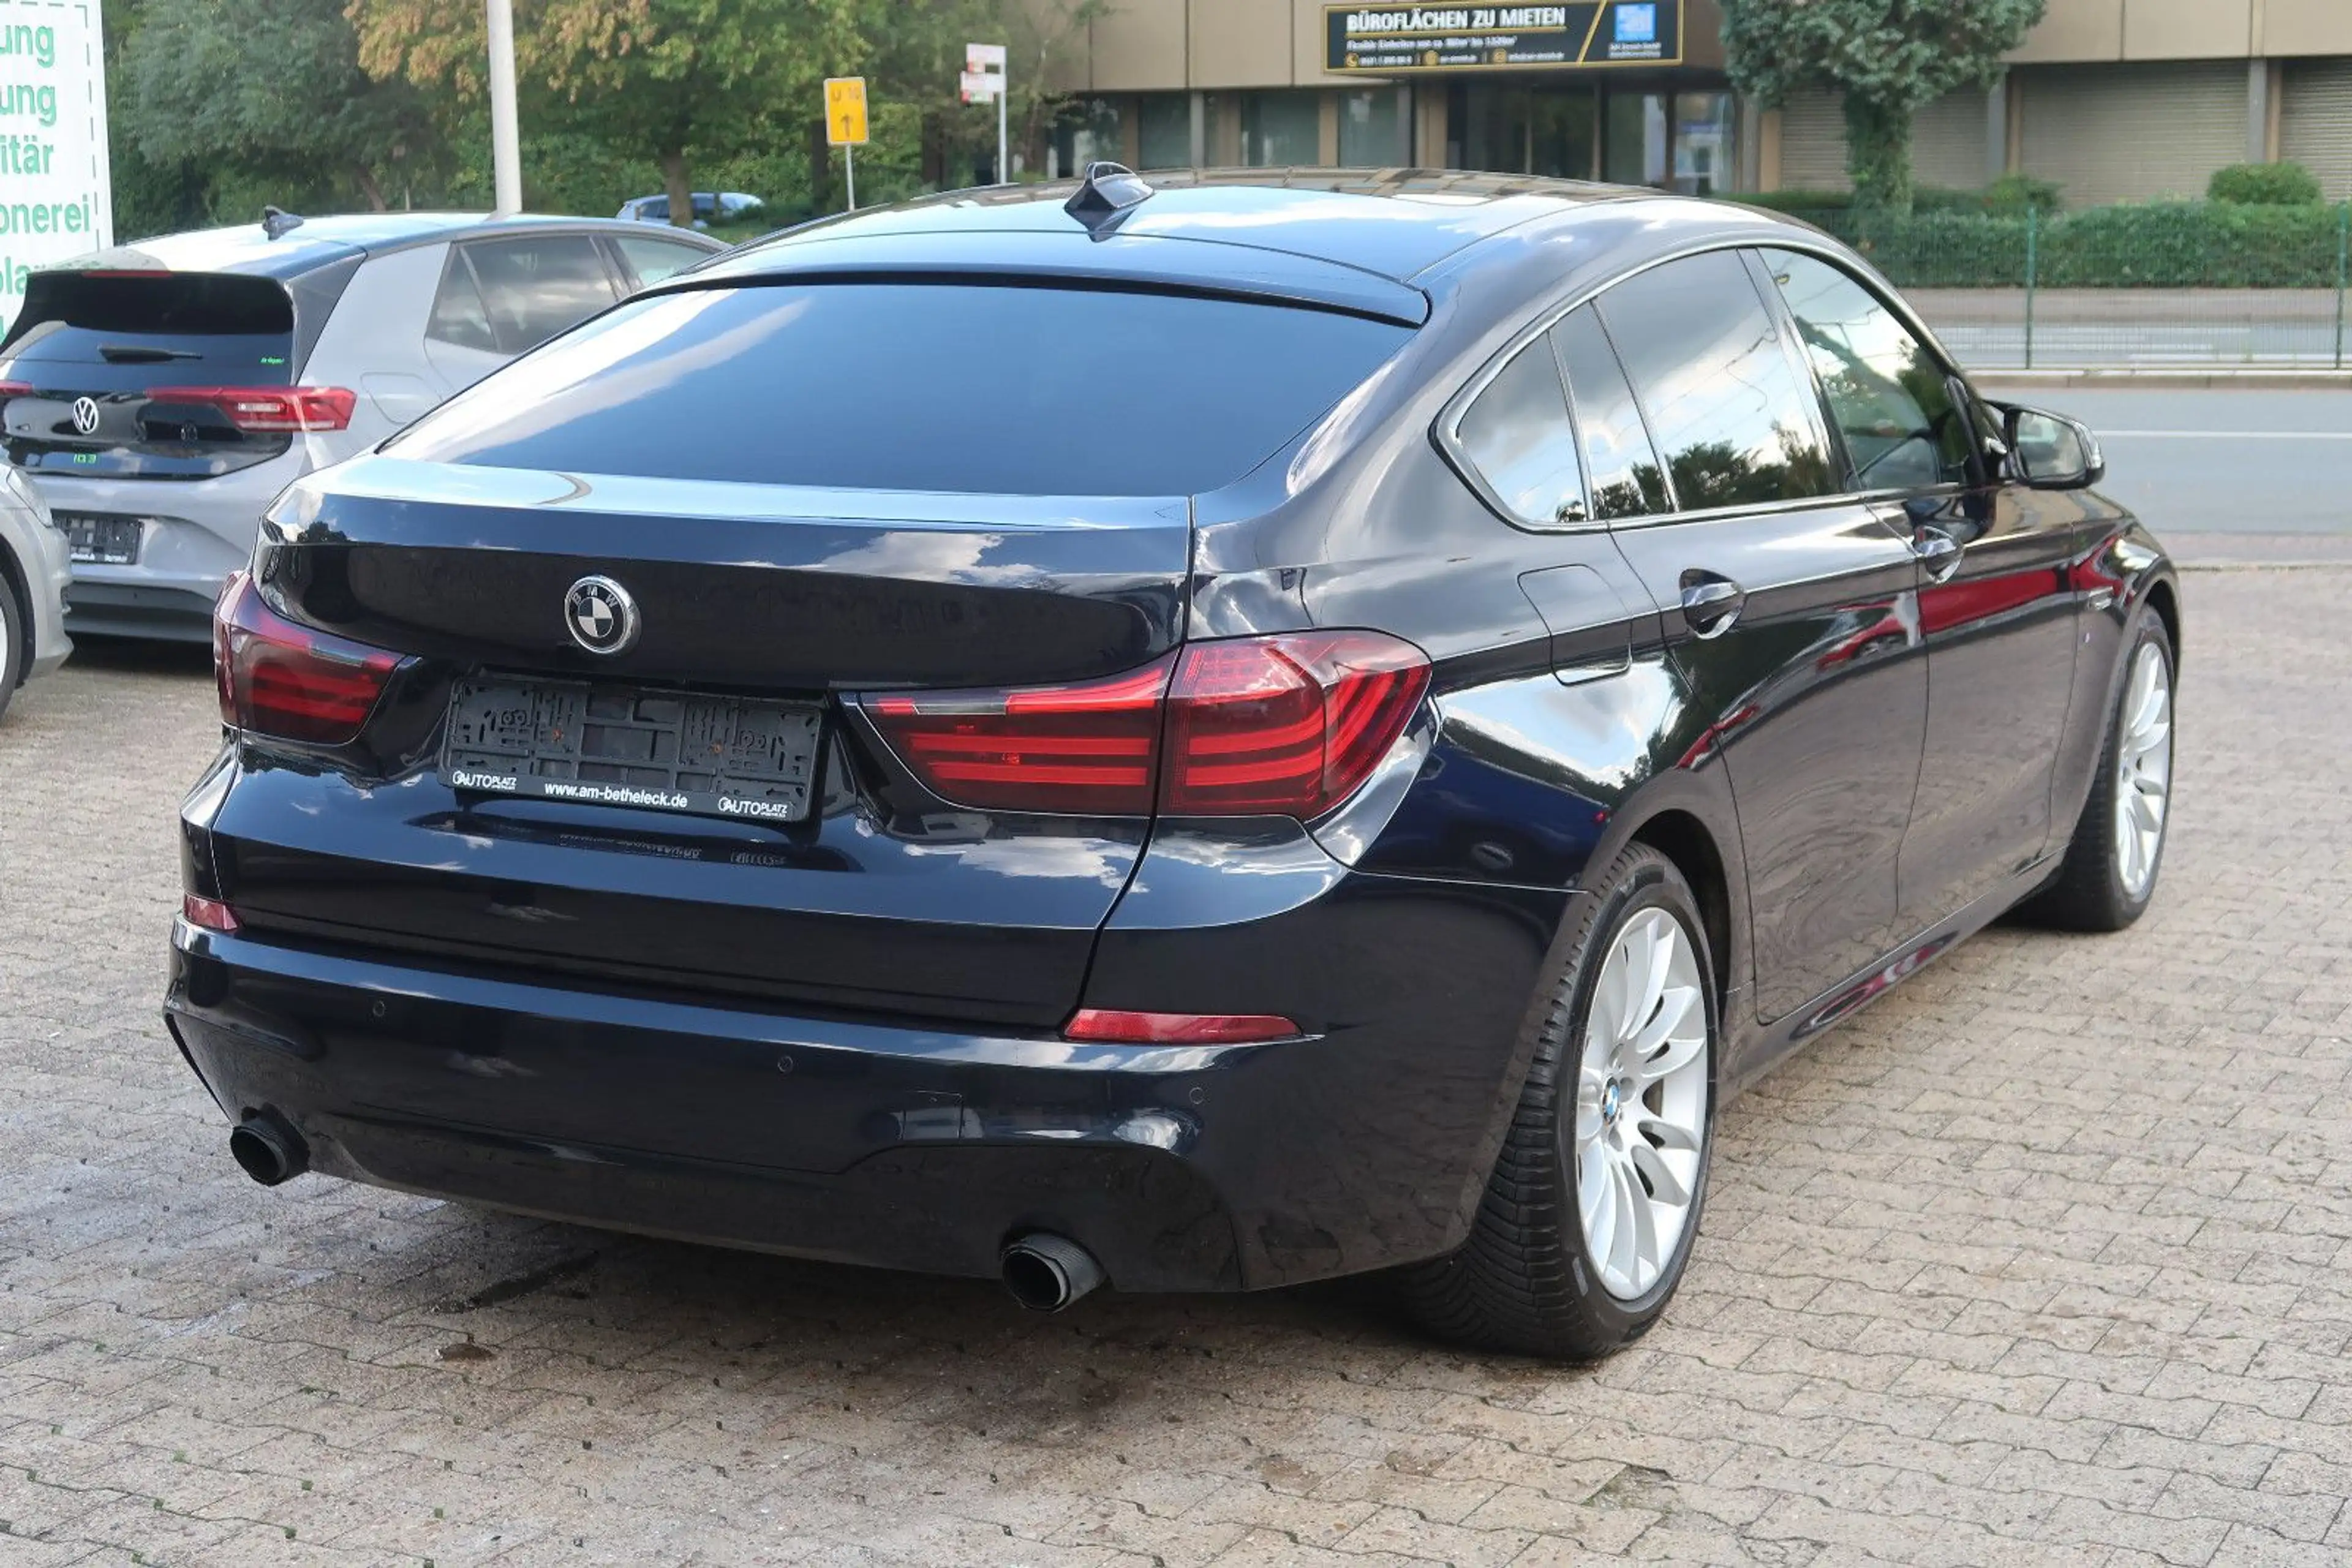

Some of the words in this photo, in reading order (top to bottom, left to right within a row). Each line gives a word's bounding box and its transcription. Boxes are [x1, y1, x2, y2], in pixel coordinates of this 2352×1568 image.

[1346, 7, 1468, 32] BÜROFLÄCHEN
[1472, 9, 1495, 28] ZU
[1499, 7, 1565, 27] MIETEN
[545, 783, 688, 808] www.am-betheleck.de
